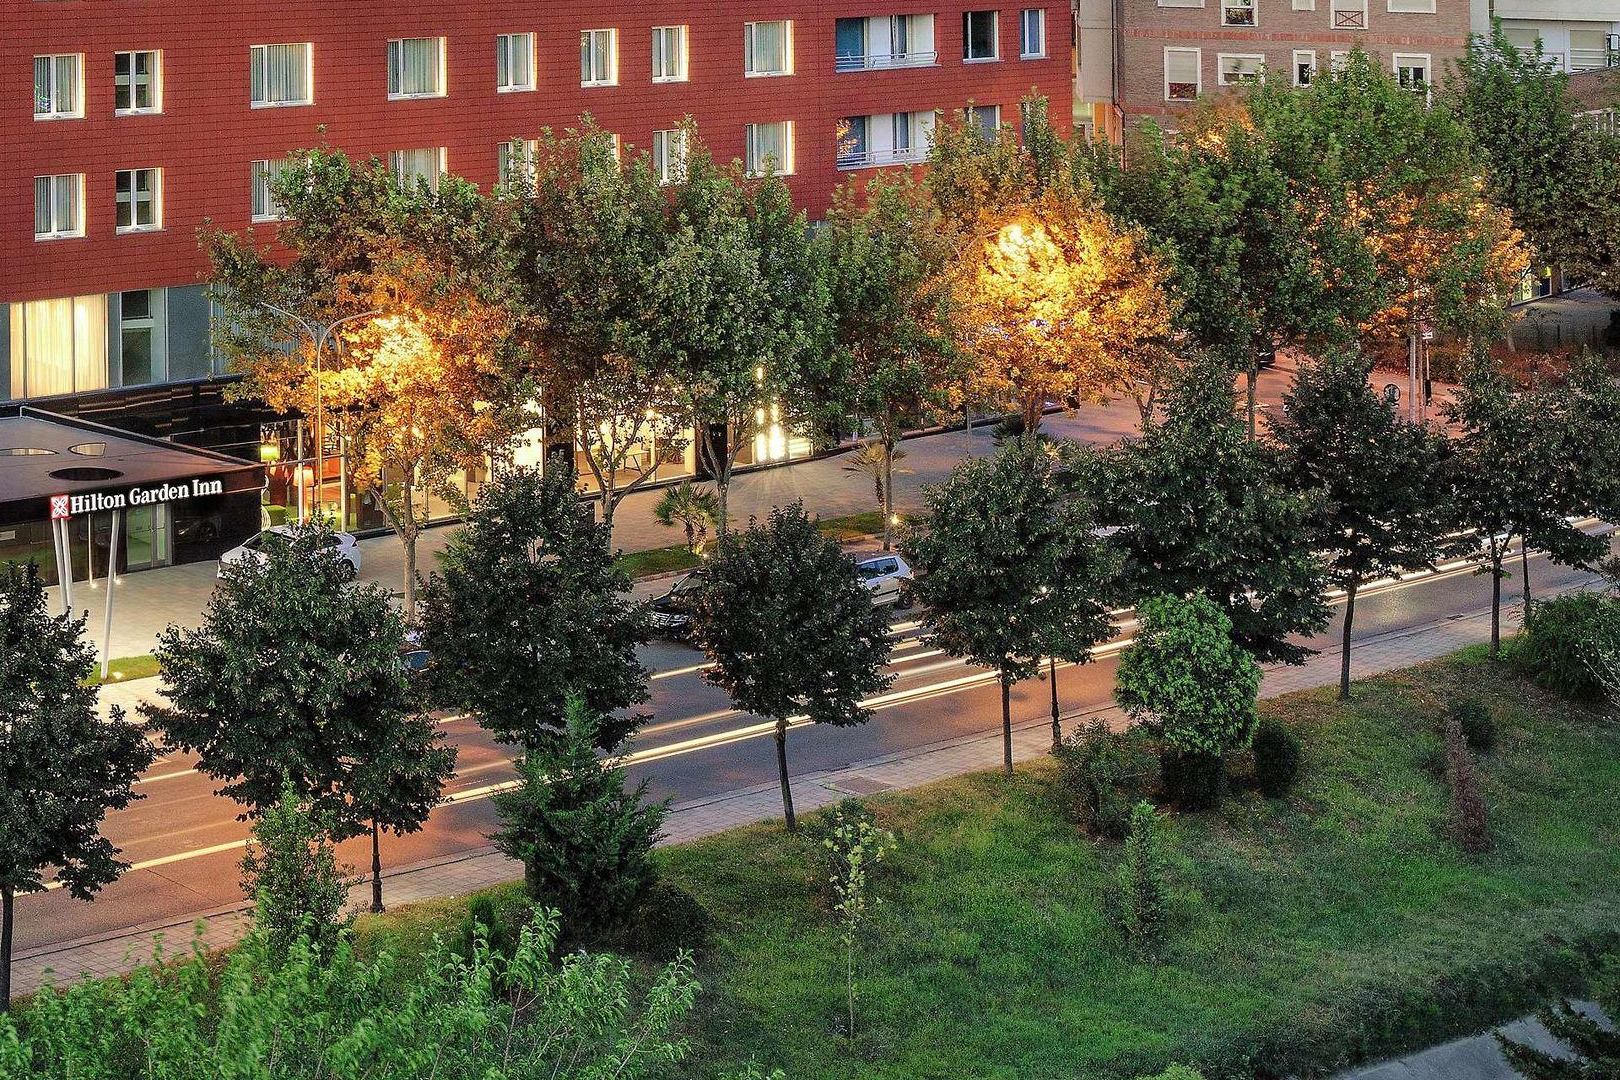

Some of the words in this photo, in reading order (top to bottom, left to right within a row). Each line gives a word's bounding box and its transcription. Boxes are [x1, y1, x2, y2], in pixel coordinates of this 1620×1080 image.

[70, 493, 126, 514] Hilton
[130, 483, 189, 505] Garden
[192, 478, 223, 496] Inn
